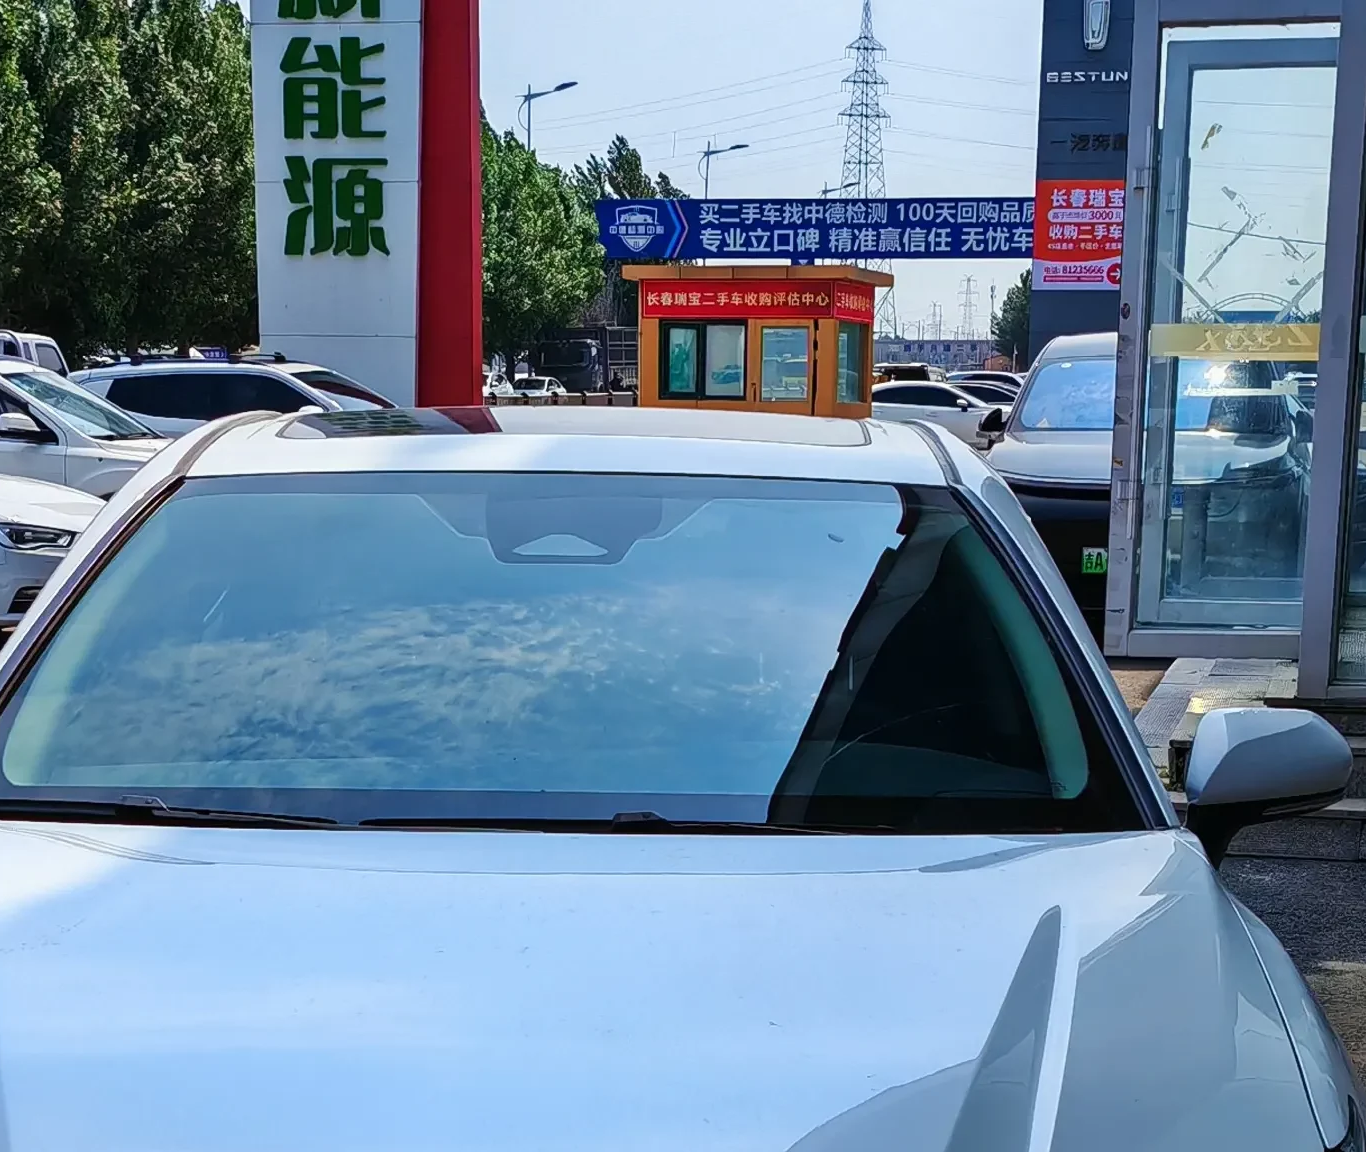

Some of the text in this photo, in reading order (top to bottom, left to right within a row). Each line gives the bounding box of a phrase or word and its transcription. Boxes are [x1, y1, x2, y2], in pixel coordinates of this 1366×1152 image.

[1046, 70, 1129, 83] BESTUN
[277, 0, 391, 257] 能源
[1050, 188, 1125, 208] 长春瑞宝
[698, 202, 888, 225] 买二手车找中德检测
[699, 227, 1034, 253] 专业立口碑 精准赢信任 无忧车
[1048, 224, 1123, 240] 收购二手车
[646, 291, 830, 307] 长春瑞宝二手车收购评估中心
